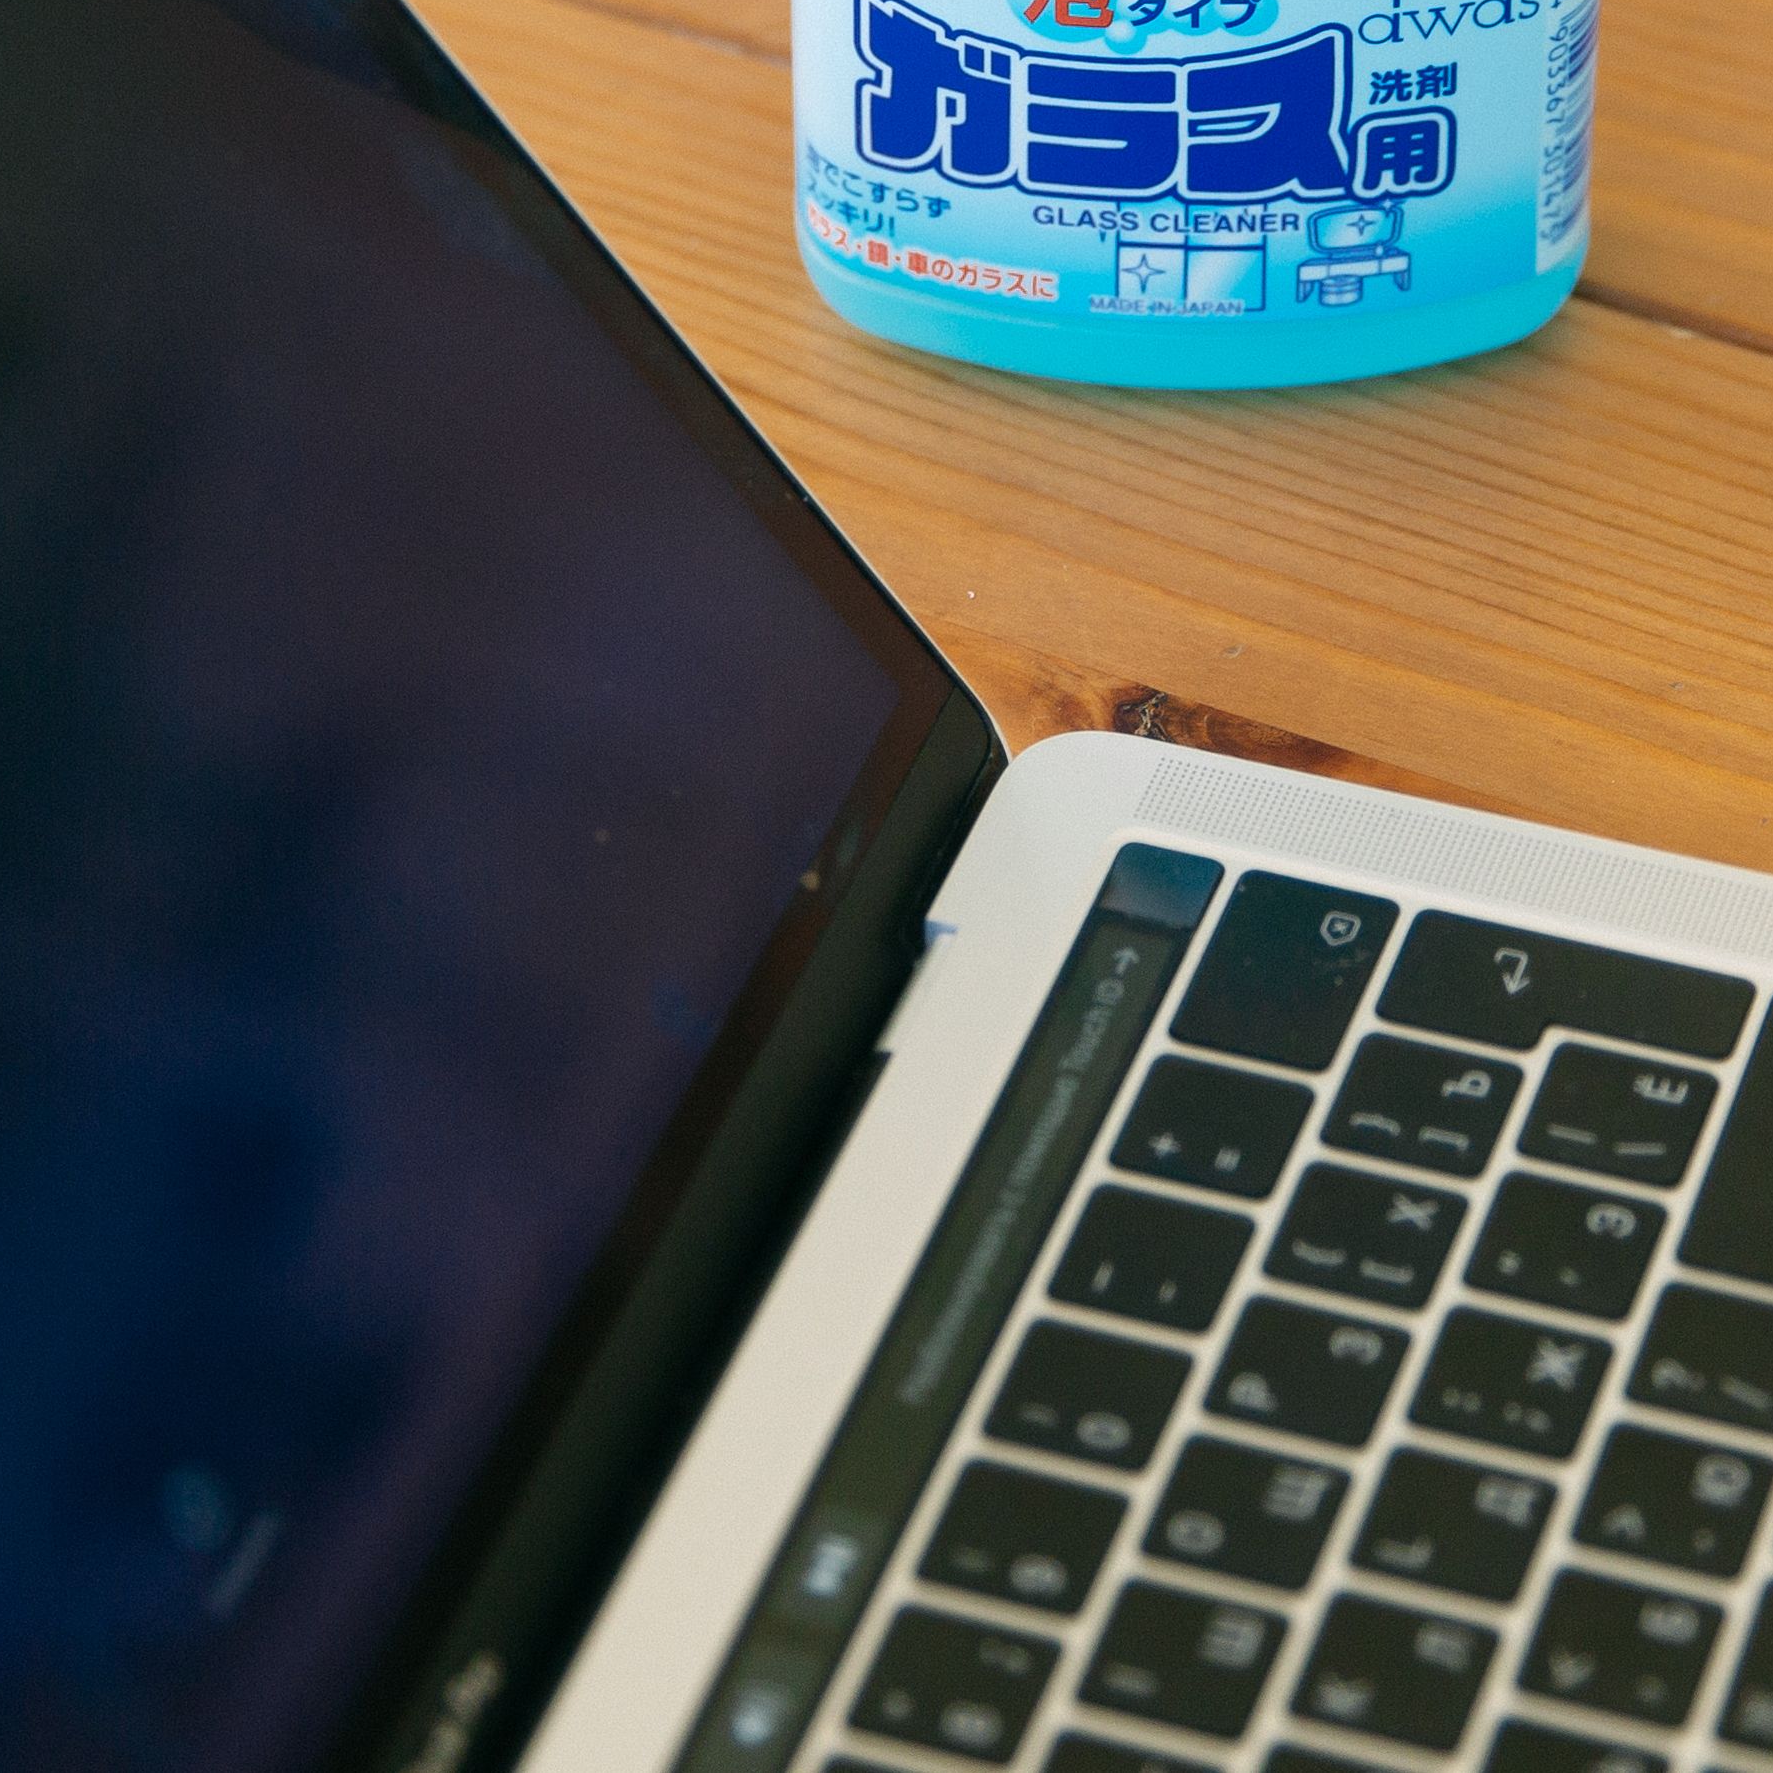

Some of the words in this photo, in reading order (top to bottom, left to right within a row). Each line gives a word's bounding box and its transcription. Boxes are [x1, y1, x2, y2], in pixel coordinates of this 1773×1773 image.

[1369, 62, 1458, 105] 洗剤
[1033, 205, 1139, 231] GLASS
[1150, 209, 1300, 234] CLEANER
[1091, 296, 1145, 313] MADE
[1178, 301, 1243, 316] JAPAN
